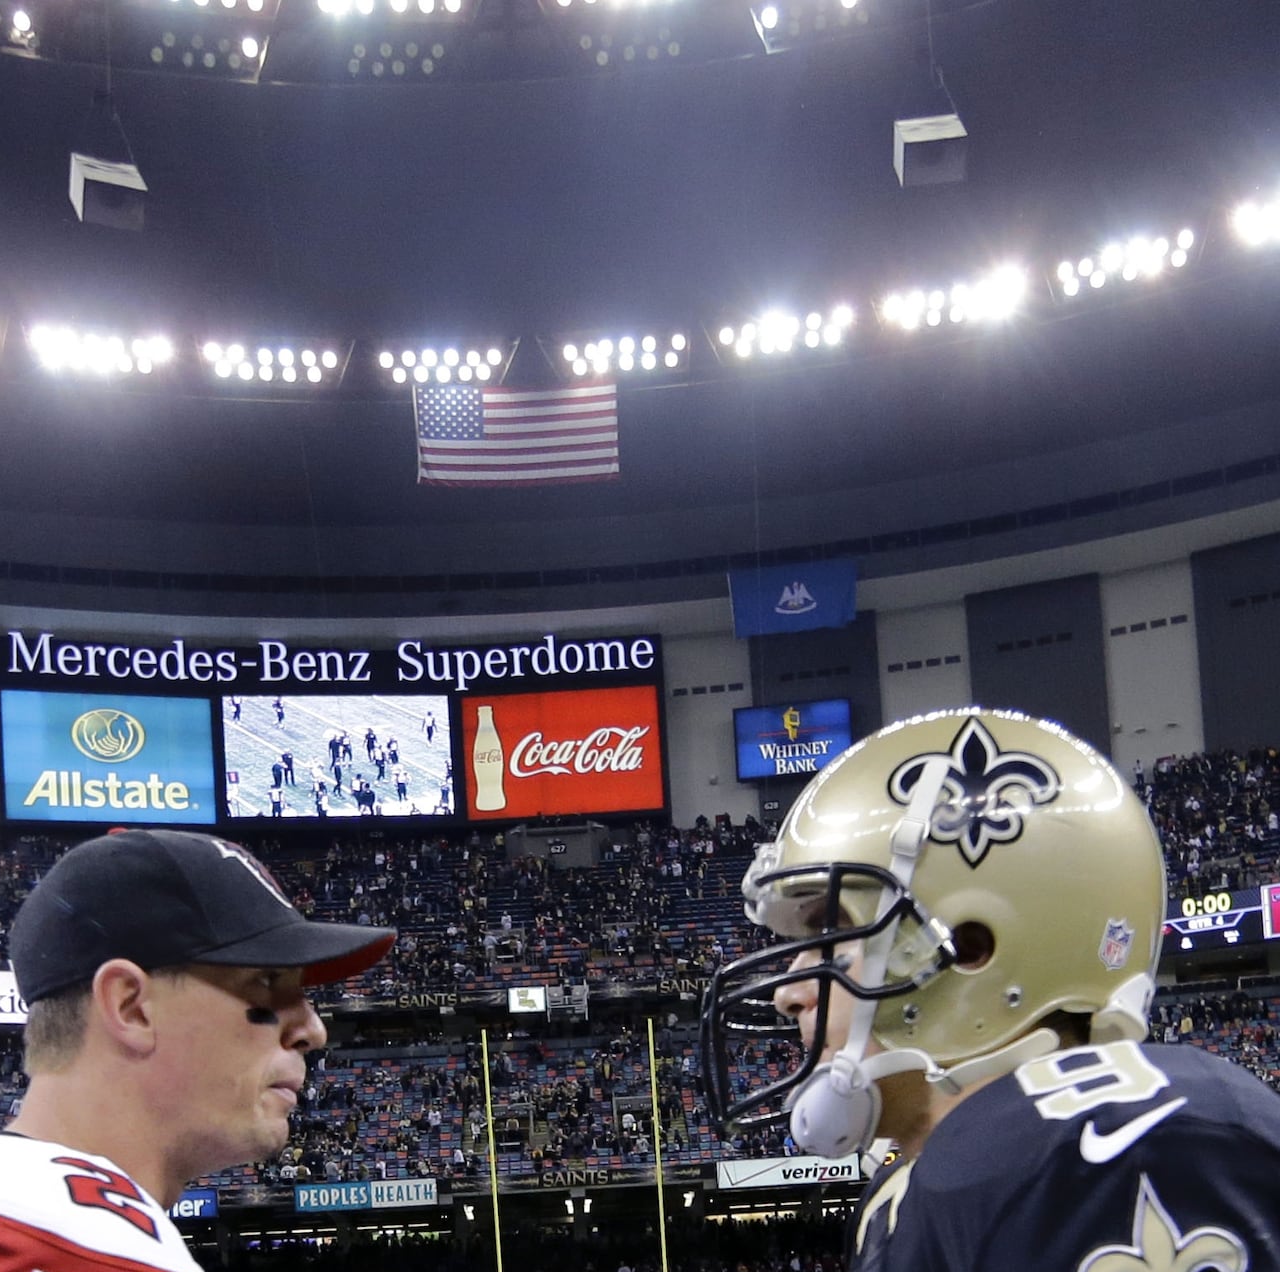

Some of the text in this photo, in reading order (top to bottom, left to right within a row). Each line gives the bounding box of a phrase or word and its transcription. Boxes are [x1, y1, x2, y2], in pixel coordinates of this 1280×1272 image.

[8, 631, 654, 691] Mercedes-Benz Superdome
[509, 724, 650, 778] Coca-Cola
[759, 740, 829, 760] WHITNEY
[775, 758, 818, 774] BANK
[23, 770, 189, 811] Allstate
[551, 844, 566, 853] 627
[1182, 893, 1231, 917] 0:00
[660, 978, 711, 993] SAINT
[399, 993, 457, 1008] SAINTS
[1016, 1040, 1170, 1120] 9
[543, 1169, 609, 1188] SAINTS
[782, 1163, 853, 1181] verizon
[52, 1156, 160, 1242] 2
[299, 1183, 435, 1208] PEOPLES HEALTH
